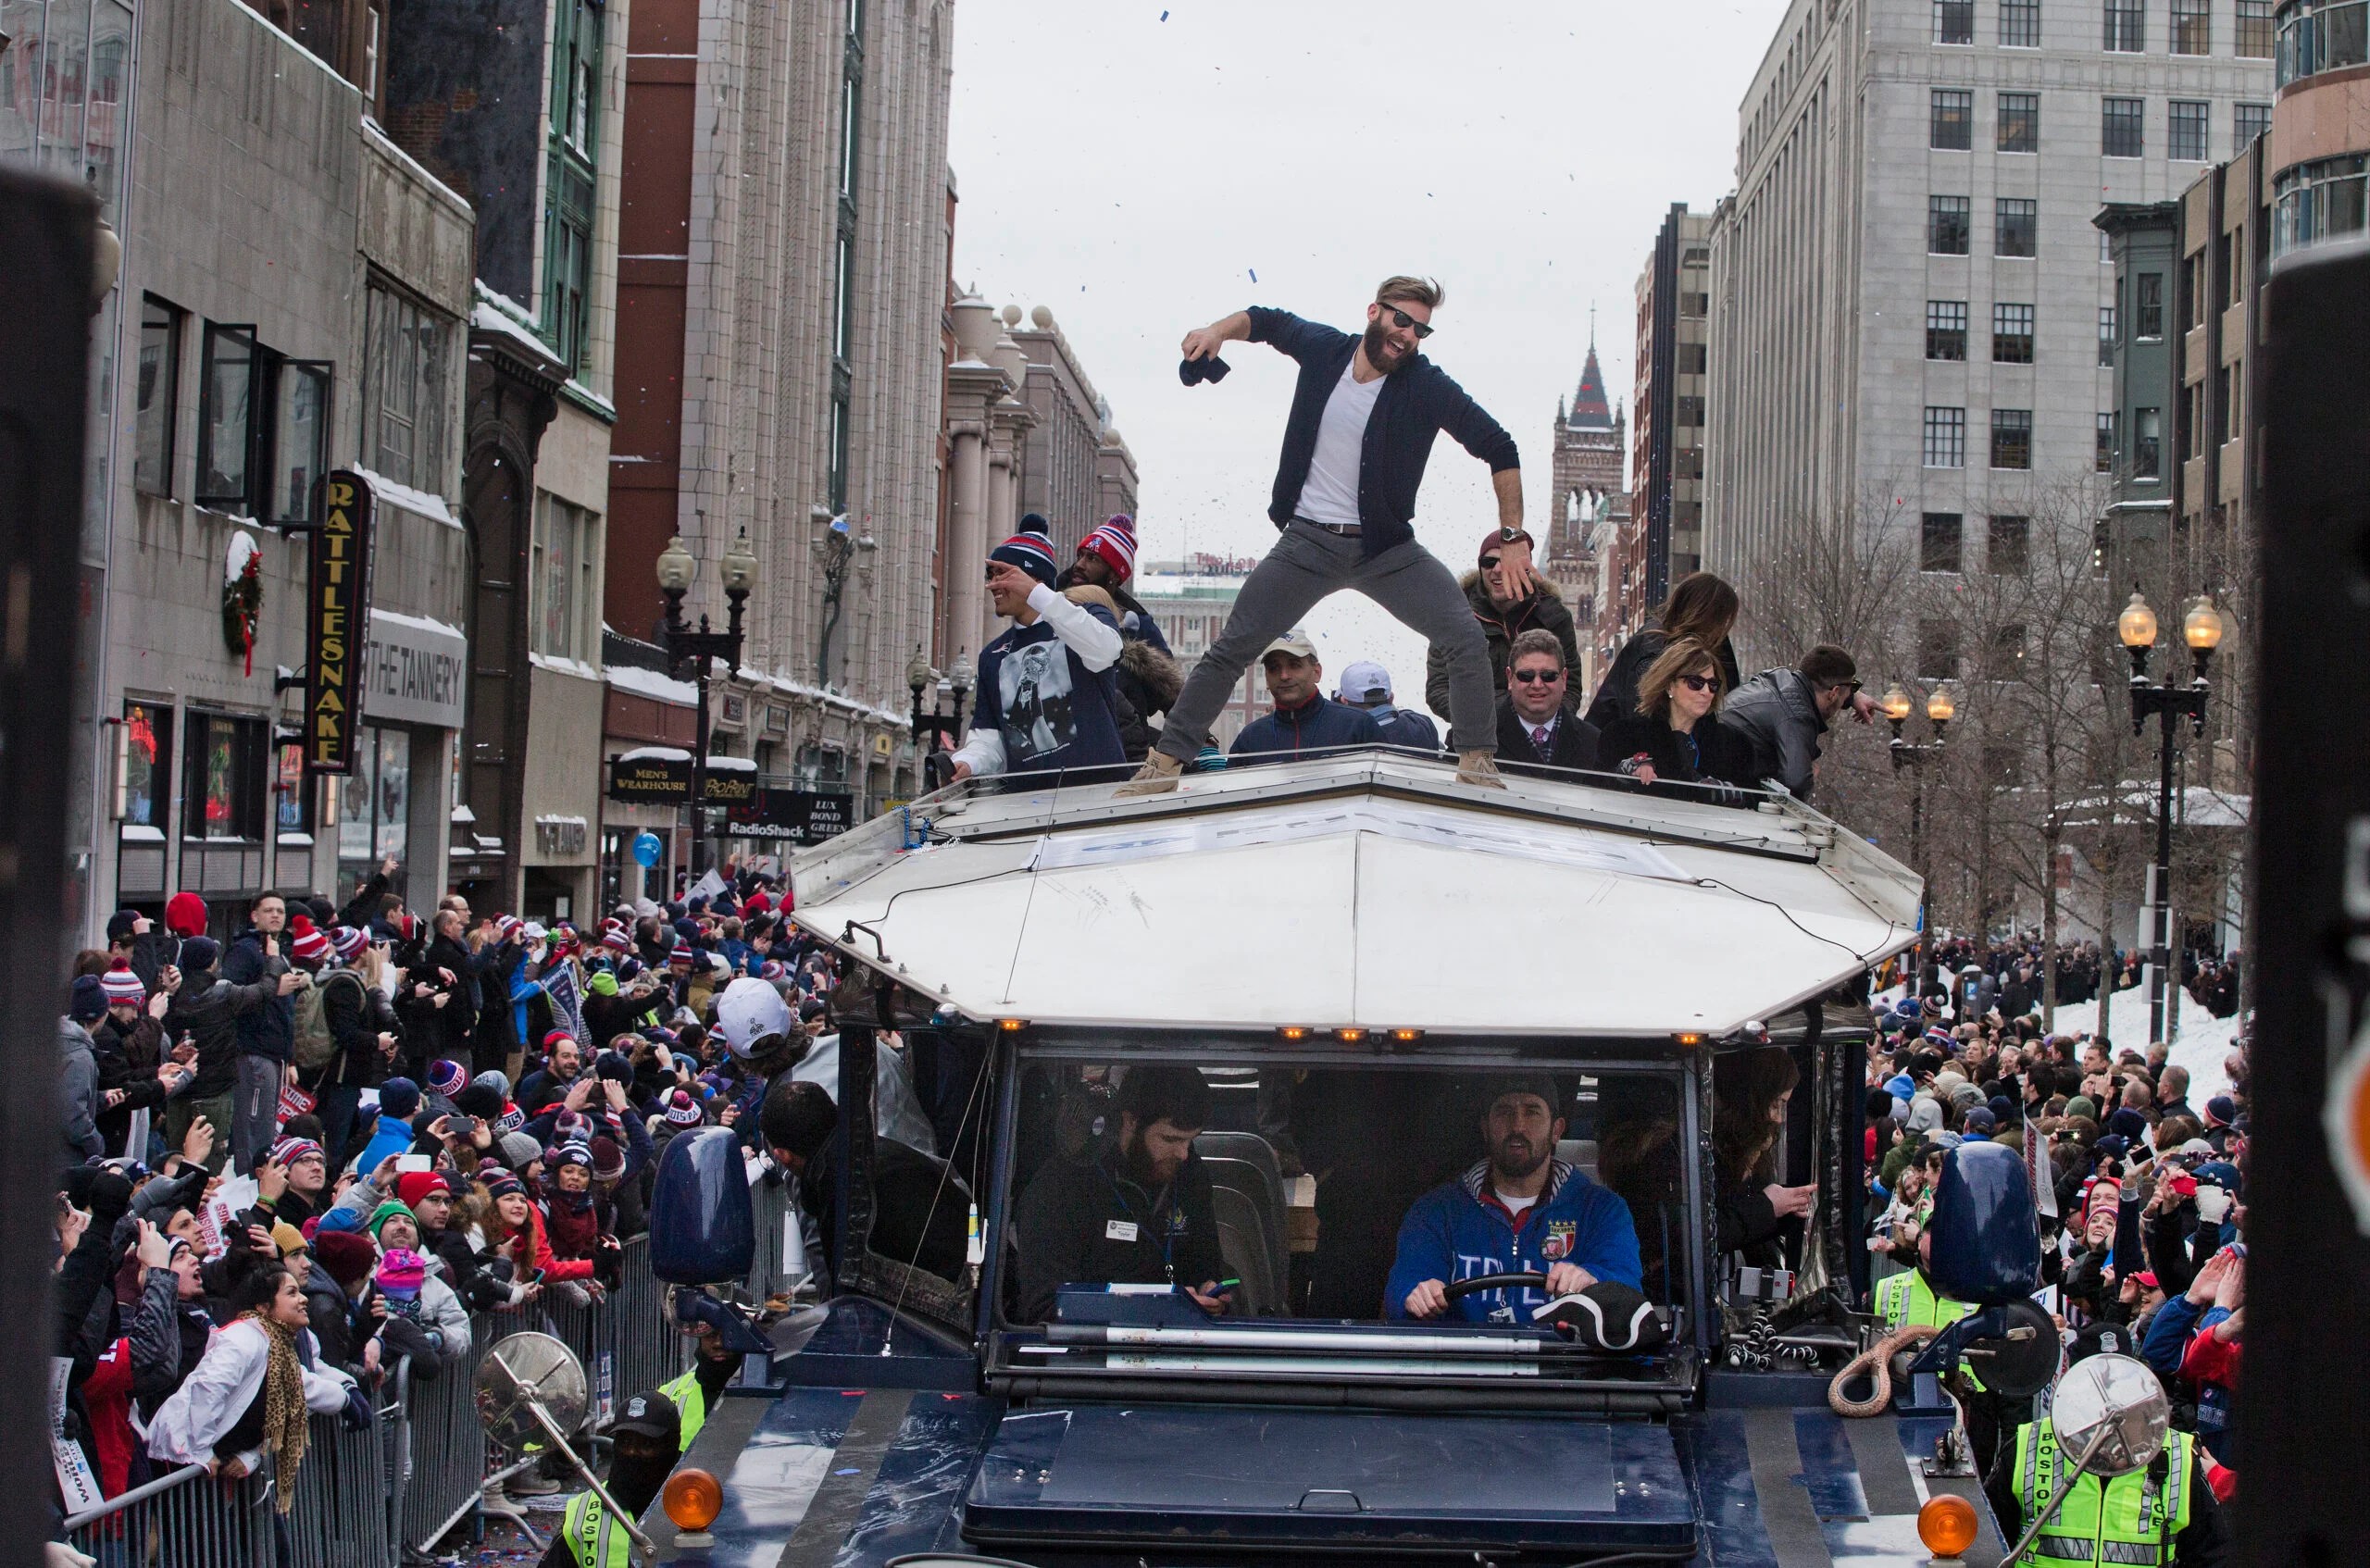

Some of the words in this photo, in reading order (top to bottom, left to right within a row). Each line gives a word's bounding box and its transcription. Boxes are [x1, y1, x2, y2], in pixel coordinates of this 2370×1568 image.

[316, 483, 354, 764] RATTLESNAKE
[369, 641, 398, 695] THE
[401, 646, 461, 705] TANNERY
[635, 769, 668, 779] MEN'S
[617, 778, 686, 791] WEARHOUSE
[816, 800, 837, 810] LUX
[810, 812, 842, 822] BOND
[730, 822, 805, 838] RadioShack
[810, 823, 848, 833] GREEN
